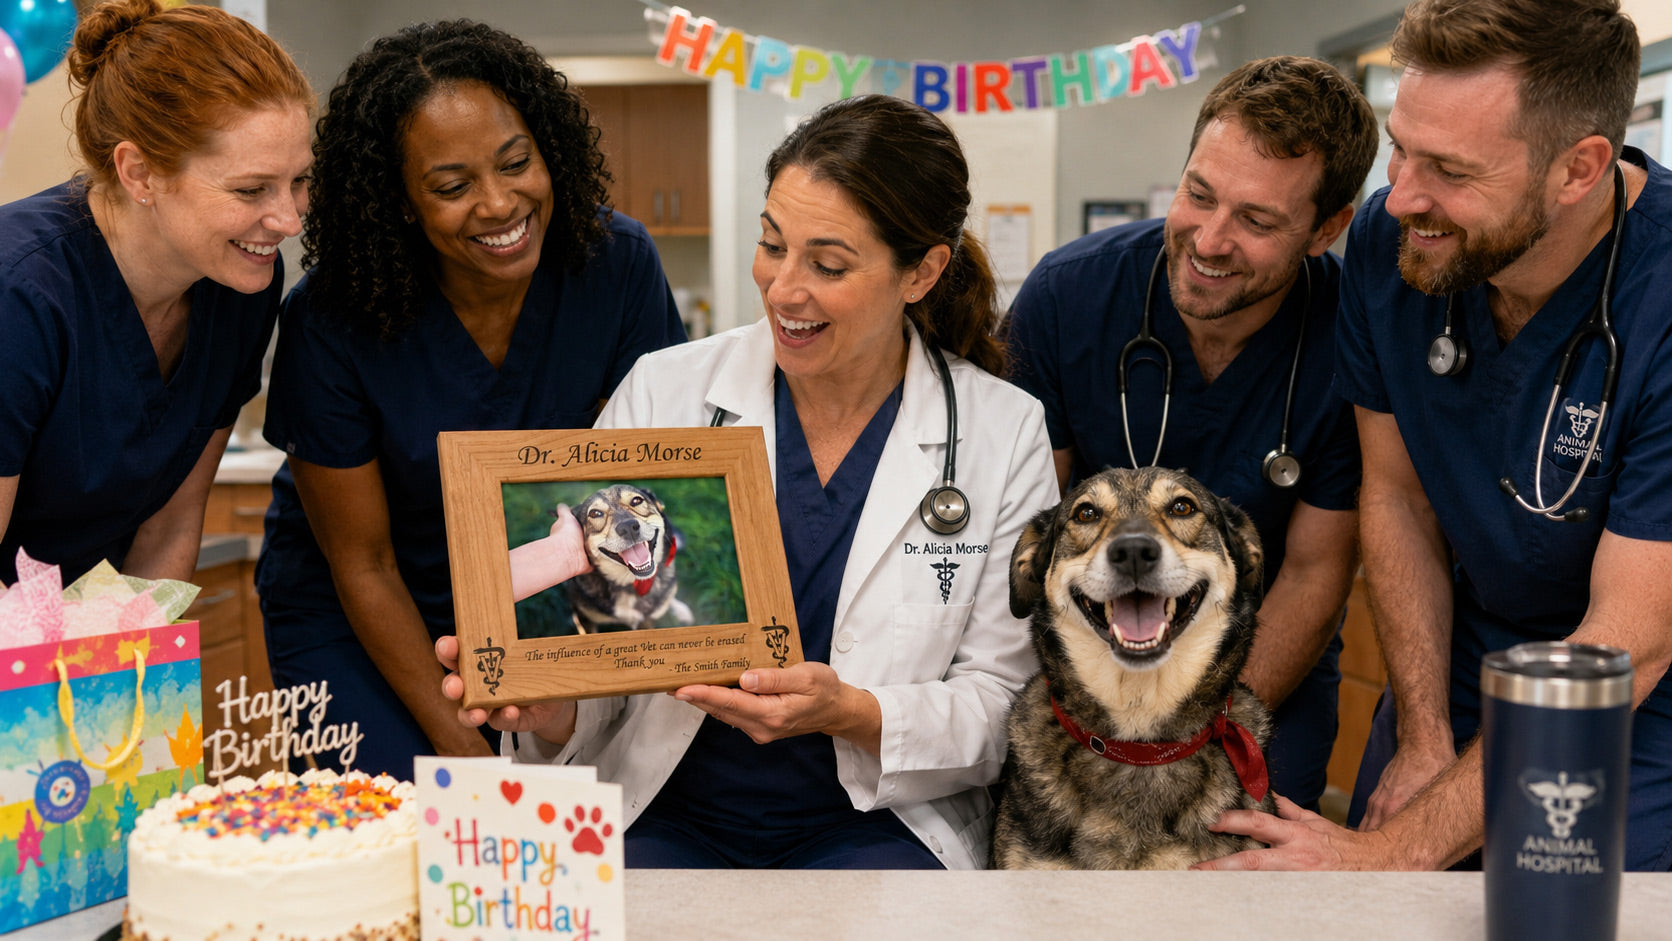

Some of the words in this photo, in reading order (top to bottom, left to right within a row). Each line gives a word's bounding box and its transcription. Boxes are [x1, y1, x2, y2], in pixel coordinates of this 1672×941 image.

[656, 13, 871, 101] HAPPY
[913, 22, 1202, 113] BIRTHDAY
[518, 446, 555, 465] Dr.
[561, 442, 629, 467] Alicia
[636, 443, 702, 462] Morse
[1553, 442, 1602, 463] HOSPIAL
[904, 543, 920, 554] Dr.
[923, 543, 952, 554] Alicia
[956, 543, 989, 554] Morse
[525, 650, 544, 662] The
[546, 647, 592, 663] influence
[593, 644, 605, 659] of
[613, 645, 638, 658] great
[640, 641, 657, 653] Vet
[659, 642, 675, 651] can
[678, 640, 702, 650] never
[705, 636, 715, 648] be
[717, 634, 746, 646] erased
[614, 658, 644, 670] Thank
[644, 658, 666, 670] you
[674, 663, 692, 673] The
[694, 660, 719, 672] Smith
[721, 658, 751, 671] Family
[215, 675, 333, 728] Happy
[203, 713, 364, 778] Birthday
[453, 818, 568, 886] Happy
[1523, 835, 1597, 855] ANIMAL
[1516, 853, 1603, 874] HOSPITAL
[446, 882, 600, 941] Birthday
